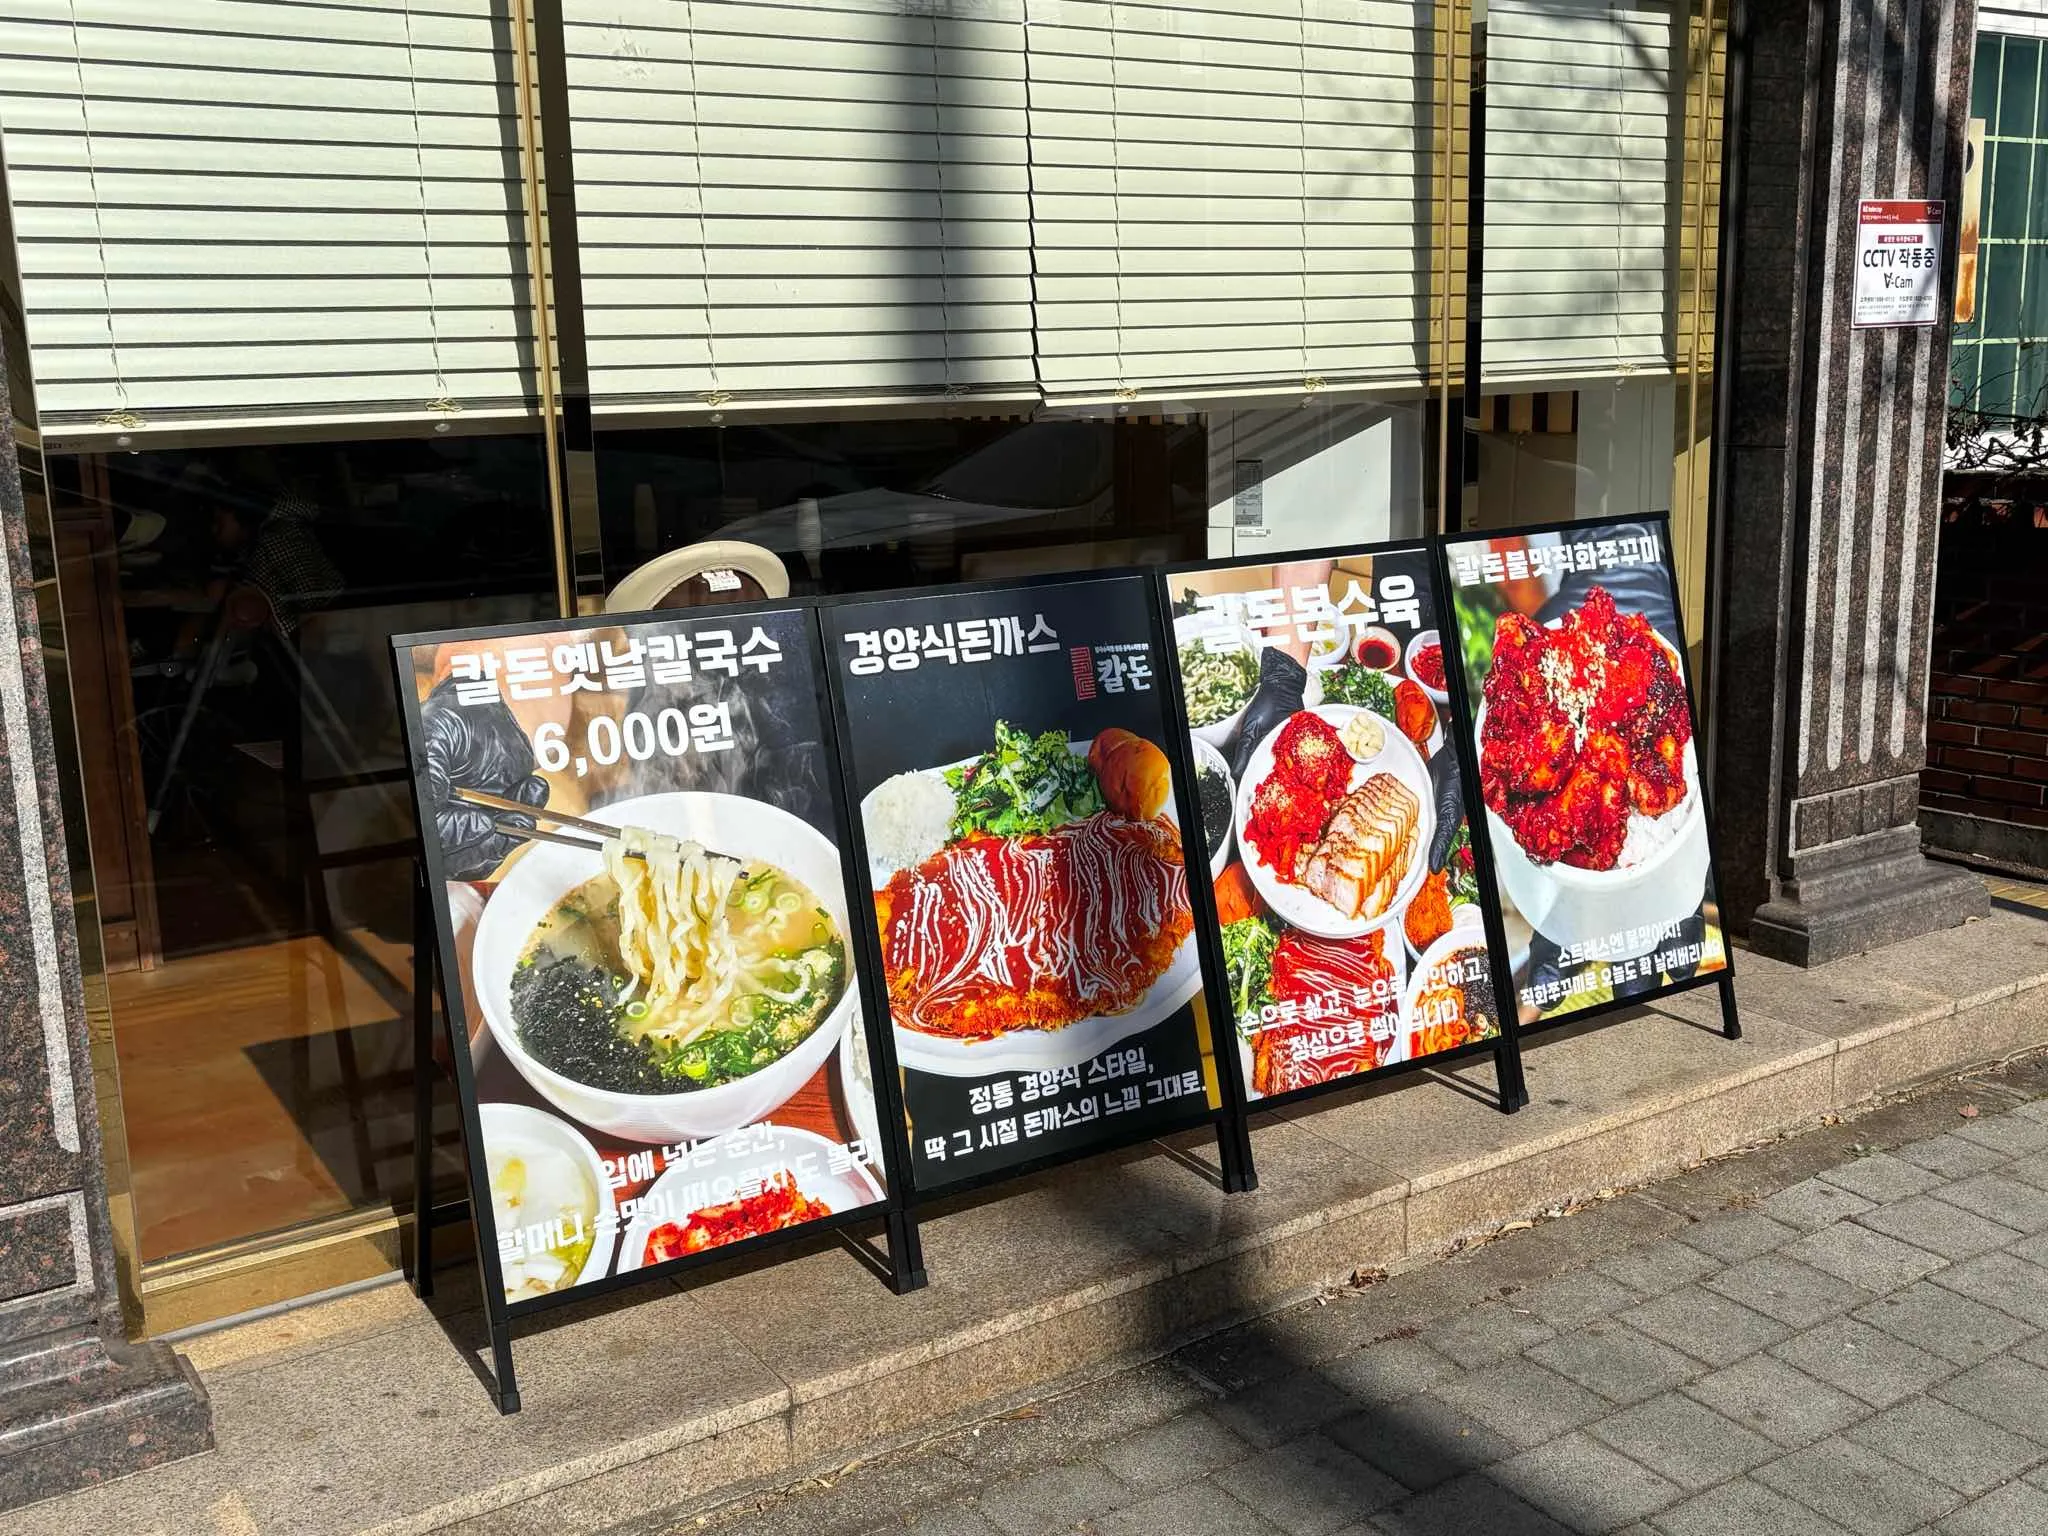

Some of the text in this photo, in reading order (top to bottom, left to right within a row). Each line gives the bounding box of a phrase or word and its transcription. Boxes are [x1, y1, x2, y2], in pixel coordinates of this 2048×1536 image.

[1863, 248, 1935, 268] CCTV 작동중
[1884, 272, 1913, 288] V-Cam
[1455, 535, 1661, 587] 칼돈불맛직화쭈꾸미
[450, 626, 783, 707] 칼돈옛날칼국수
[844, 613, 1061, 676] 경양식돈까스
[1097, 654, 1153, 693] 칼돈
[533, 701, 736, 777] 6,000원
[1558, 928, 1624, 968] 스트레스엔
[1240, 1000, 1299, 1036] 손으로
[1411, 957, 1488, 996] 인하고,
[1519, 971, 1598, 1007] 직화쭈꾸미로
[1600, 960, 1637, 987] 오늘도
[1289, 1020, 1367, 1062] 정성으로
[968, 1047, 1154, 1115] 정통 경양식 스타일,
[924, 1070, 1207, 1162] 딱 그 시절 돈까스의 느낌 그대로.
[497, 1212, 585, 1264] 할머니
